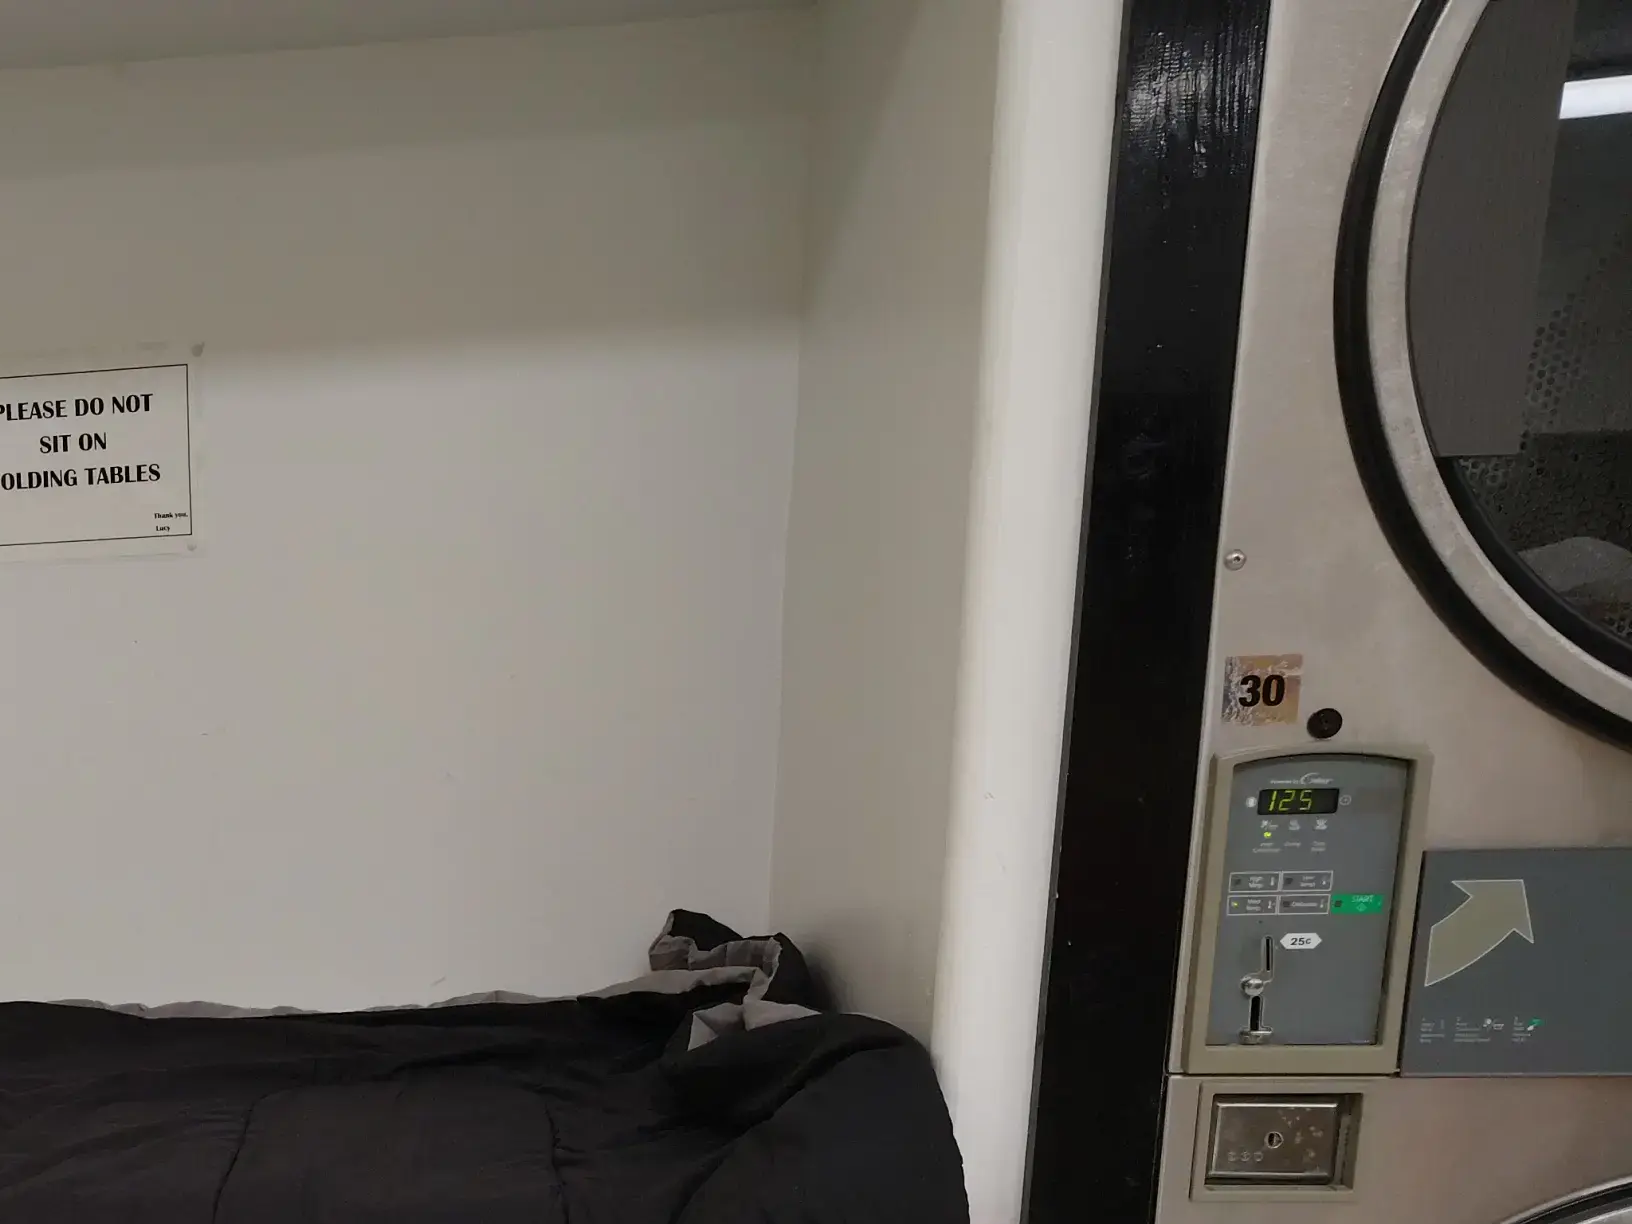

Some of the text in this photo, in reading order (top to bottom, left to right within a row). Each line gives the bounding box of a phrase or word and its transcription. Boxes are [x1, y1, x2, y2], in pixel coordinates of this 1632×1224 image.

[74, 397, 104, 416] DO
[111, 393, 153, 414] NOT
[39, 432, 107, 454] SIT ON
[84, 463, 161, 486] TABLES
[1238, 674, 1285, 707] 30
